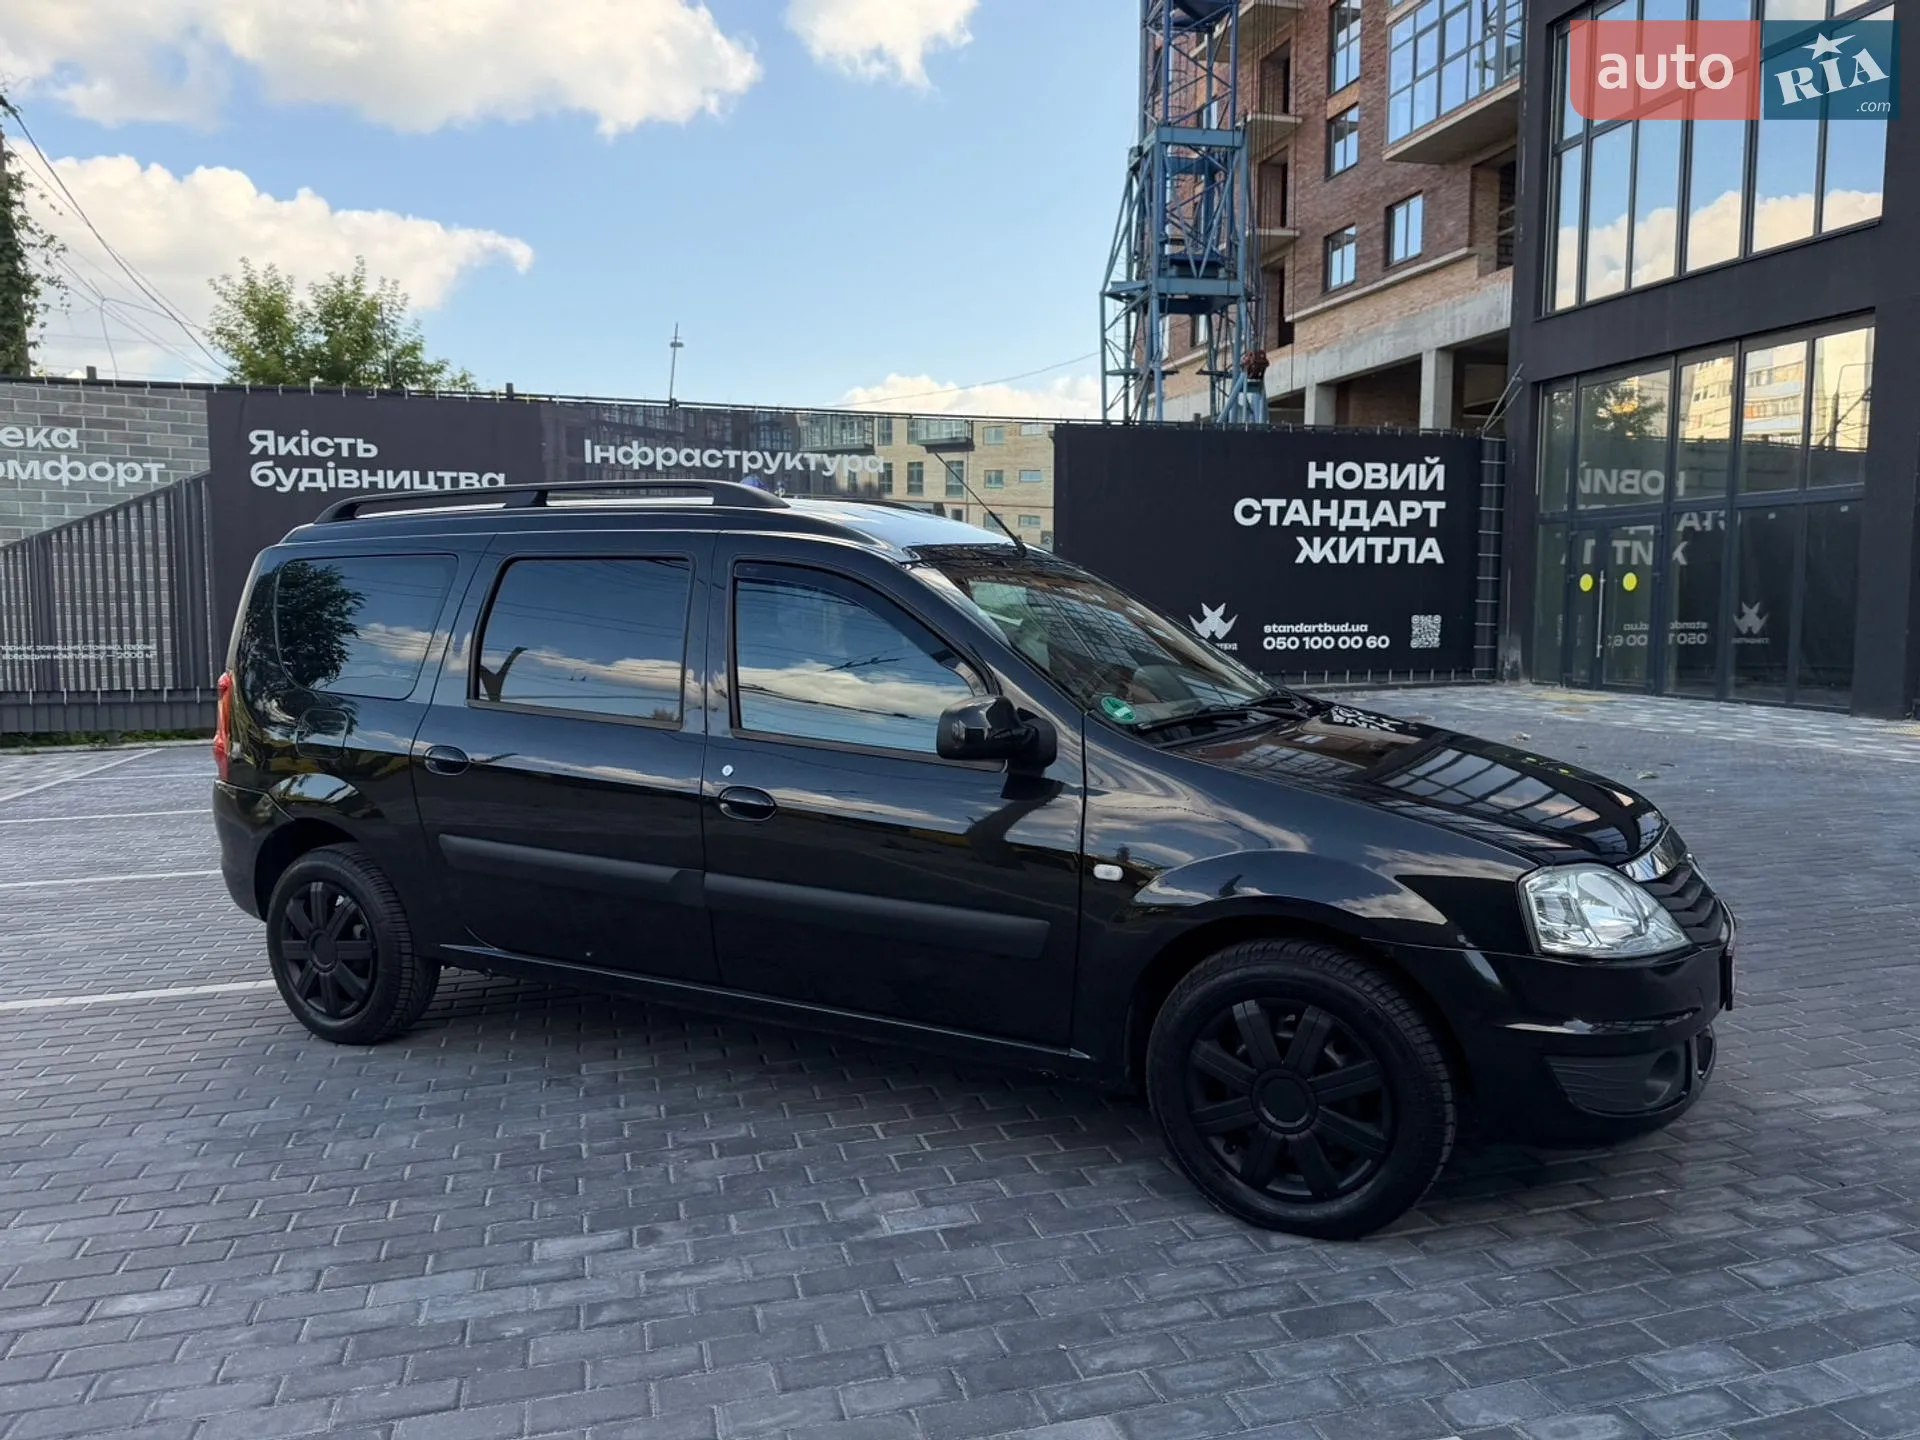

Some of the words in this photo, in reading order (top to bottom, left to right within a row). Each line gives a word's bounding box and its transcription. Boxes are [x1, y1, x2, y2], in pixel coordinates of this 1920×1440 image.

[248, 429, 378, 458] Якість
[584, 438, 885, 475] Інфраструктура
[0, 454, 166, 487] мфорт
[250, 460, 506, 493] будівництва
[1307, 456, 1445, 491] НОВИЙ
[1234, 498, 1446, 531] СТАНДАРТ
[1295, 536, 1444, 564] ЖИТЛА
[1263, 622, 1369, 634] standartbud.ua
[1263, 636, 1299, 650] 050
[1302, 636, 1336, 649] 100
[1338, 636, 1363, 649] 00
[1366, 635, 1390, 648] 60
